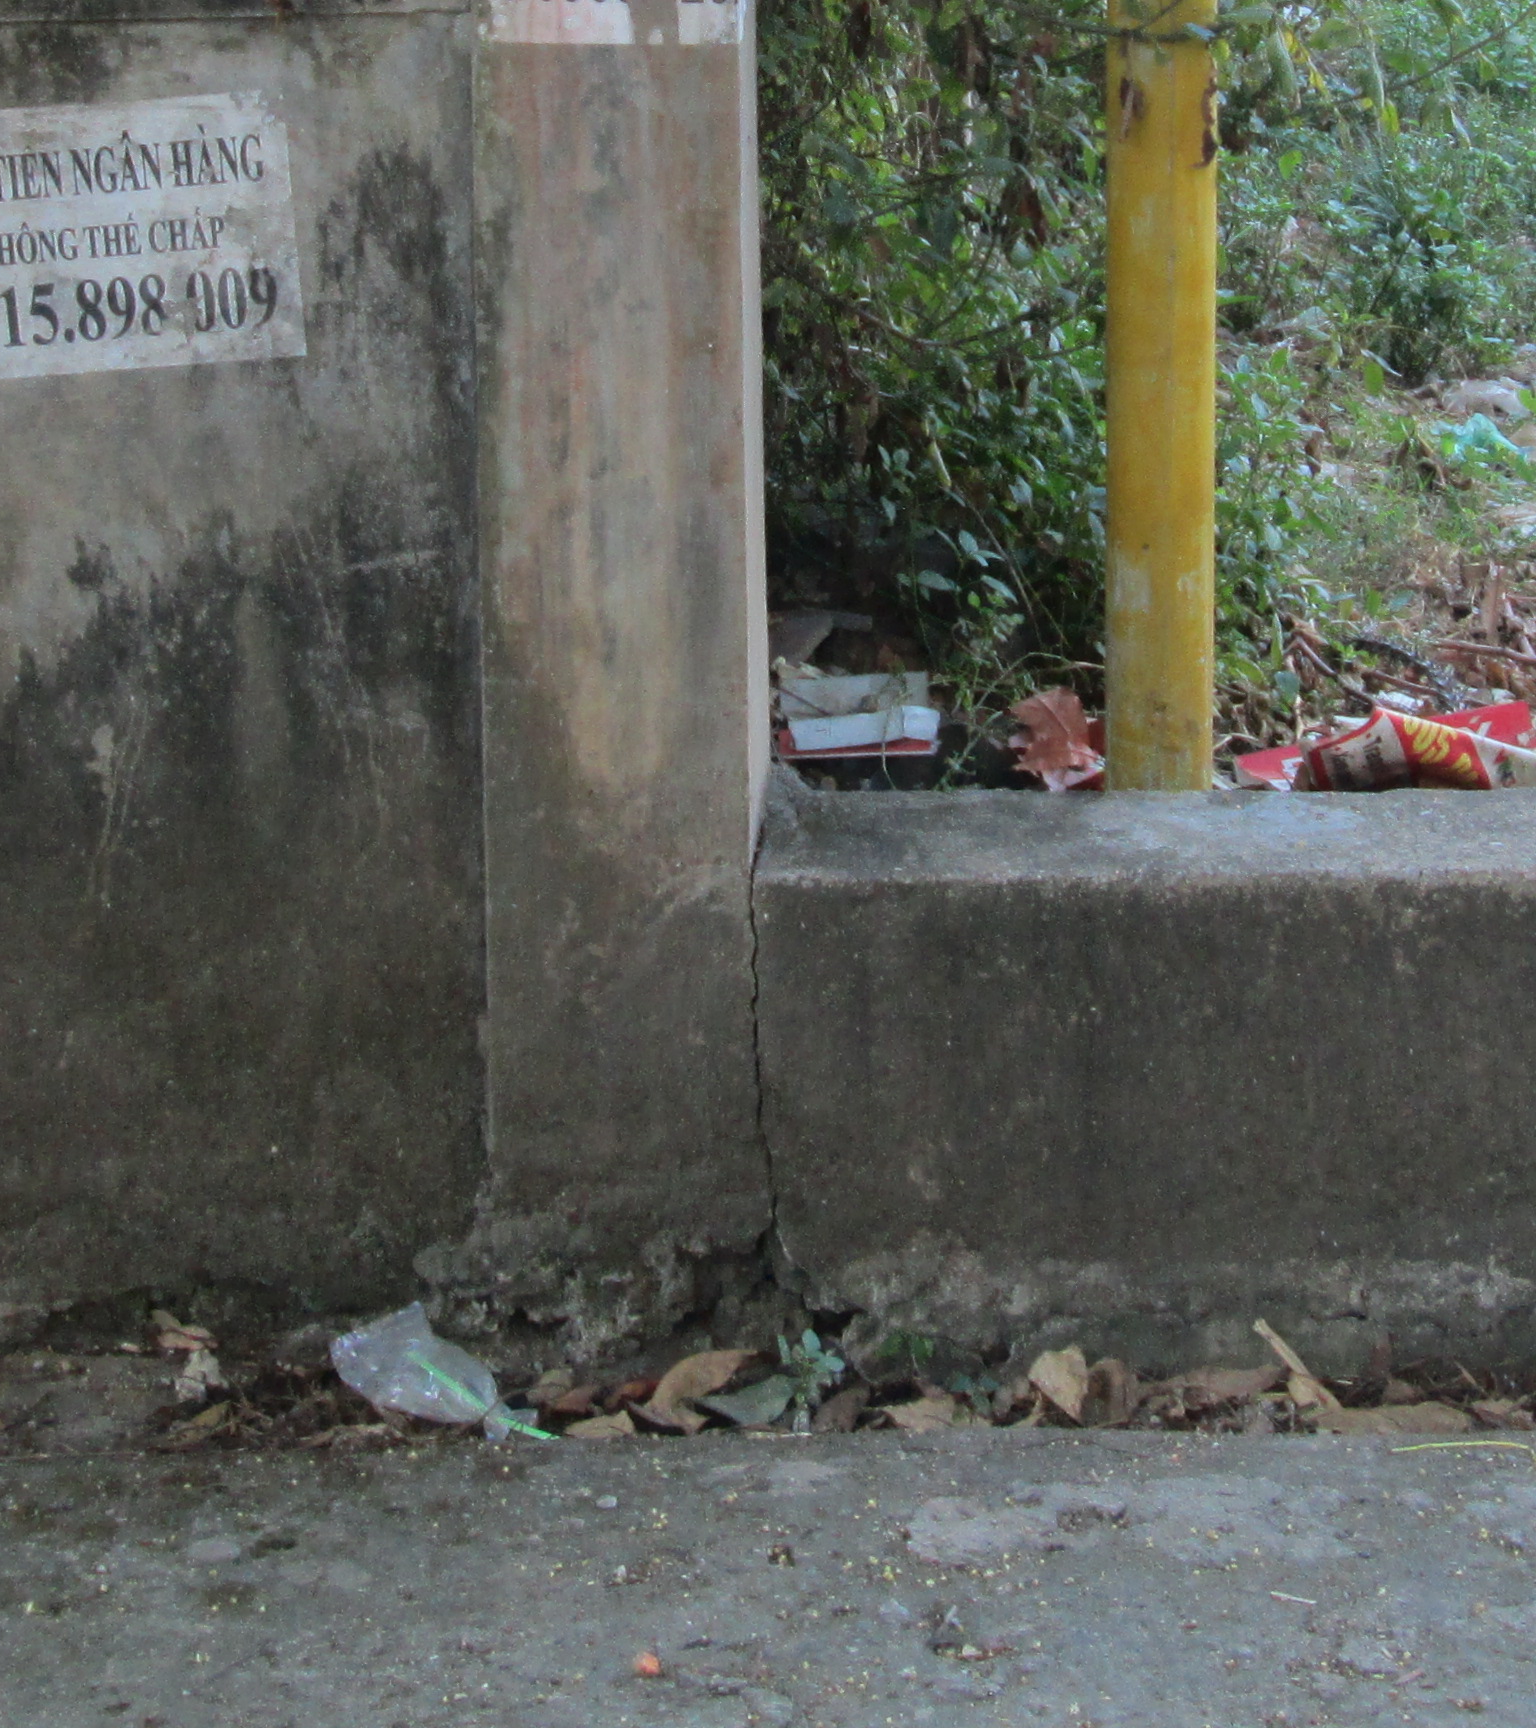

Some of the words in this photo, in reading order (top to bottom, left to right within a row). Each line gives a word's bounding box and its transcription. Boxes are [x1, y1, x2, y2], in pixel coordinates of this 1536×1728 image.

[69, 130, 162, 196] NGÂN
[167, 124, 264, 187] HÀNG
[83, 212, 142, 259] THẾ
